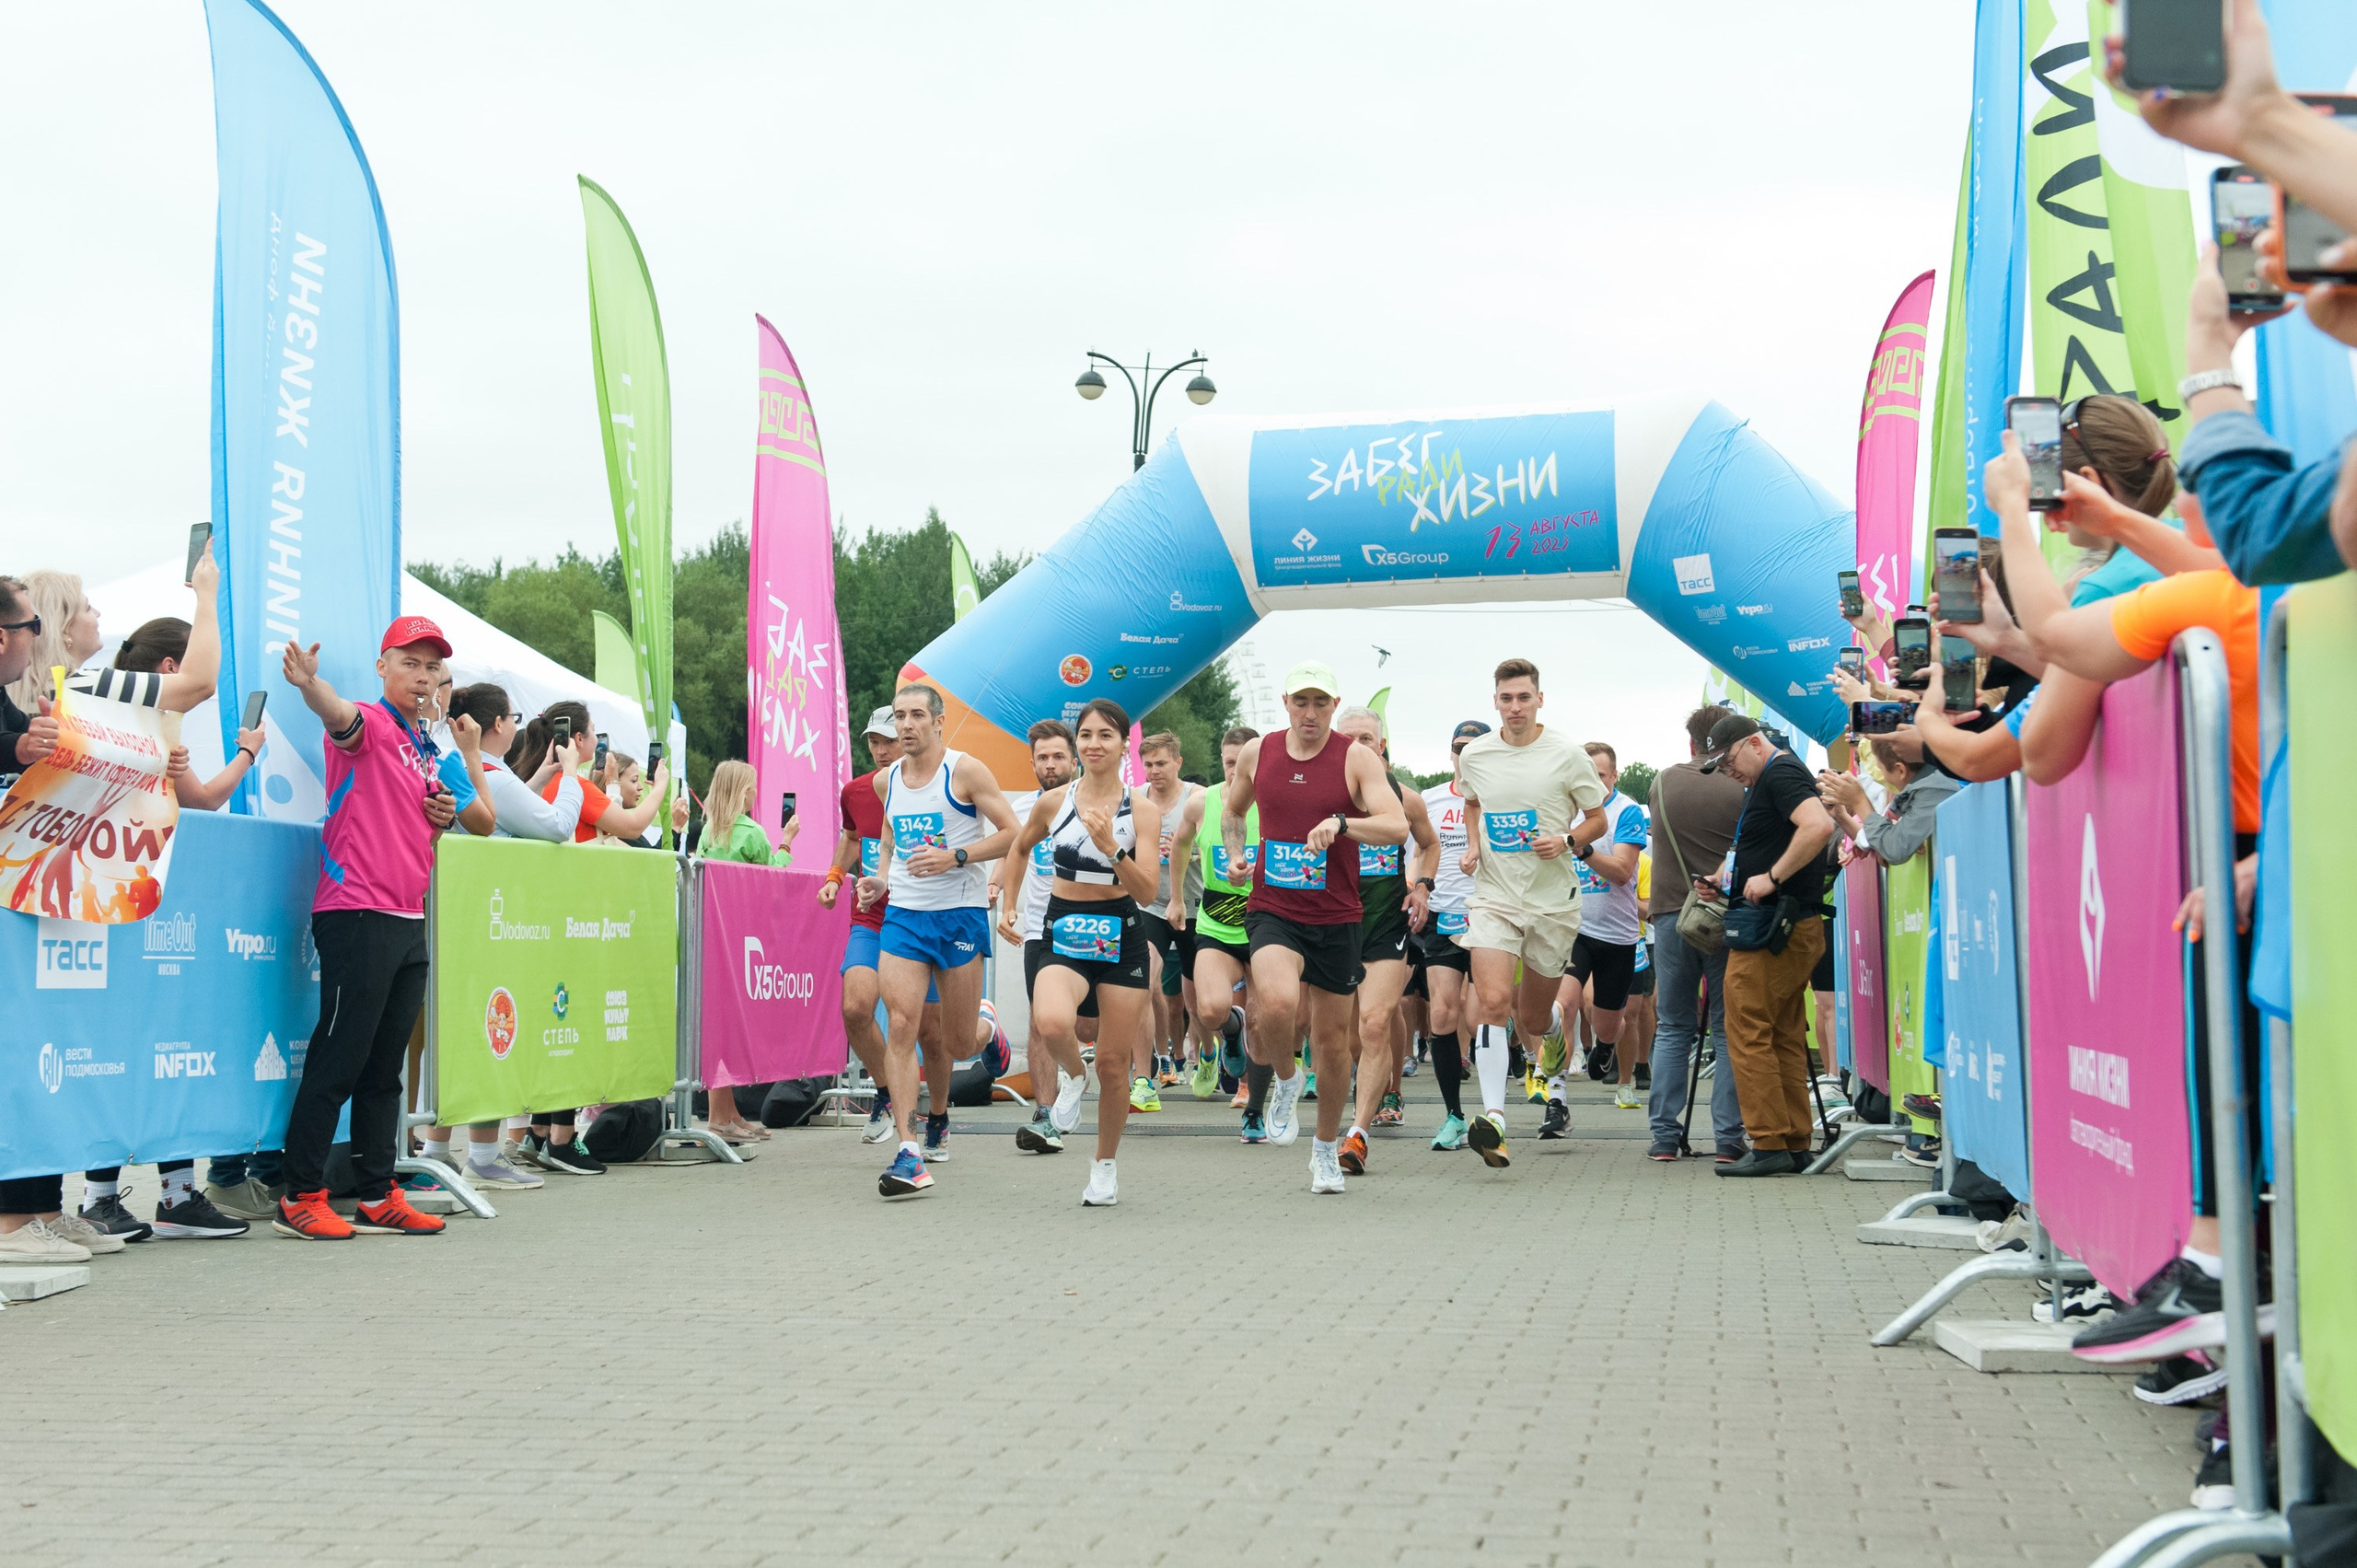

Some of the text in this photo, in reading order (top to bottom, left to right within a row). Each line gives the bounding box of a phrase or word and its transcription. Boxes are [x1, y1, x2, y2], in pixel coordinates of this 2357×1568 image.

[1307, 430, 1444, 501] ЗАБЕГ
[1377, 447, 1465, 506] РАДИ
[1404, 450, 1558, 533] ЖИЗНИ
[1483, 508, 1600, 559] 13 АВГУСТА
[1274, 554, 1341, 564] ЛИНИЯ ЖИЗНИ
[1375, 548, 1449, 565] X5Group
[1180, 603, 1223, 611] Vodovoz.ru
[1120, 633, 1179, 645] Белая Дача
[1788, 637, 1831, 653] INFOX
[1133, 666, 1172, 675] СТЕПЬ
[43, 745, 76, 772] ВЕДЬ
[70, 753, 110, 780] БЕЖИТ
[899, 816, 935, 832] 3142
[1491, 814, 1529, 829] 3336
[1439, 832, 1468, 842] Runni
[1218, 847, 1255, 860] 36
[1273, 844, 1317, 863] 3144
[502, 921, 551, 940] Vodovoz.ru
[564, 916, 631, 941] Белая Дача
[1063, 917, 1110, 935] 3226
[753, 964, 814, 1006] X5Group
[605, 990, 628, 1006] СОЮЗ
[542, 1027, 580, 1046] СТЕПЬ
[606, 1026, 628, 1042] ПАРК
[289, 1040, 309, 1051] КОВО
[65, 1062, 125, 1078] ПОДМОСКОВЬЯ
[155, 1051, 217, 1079] INFOX
